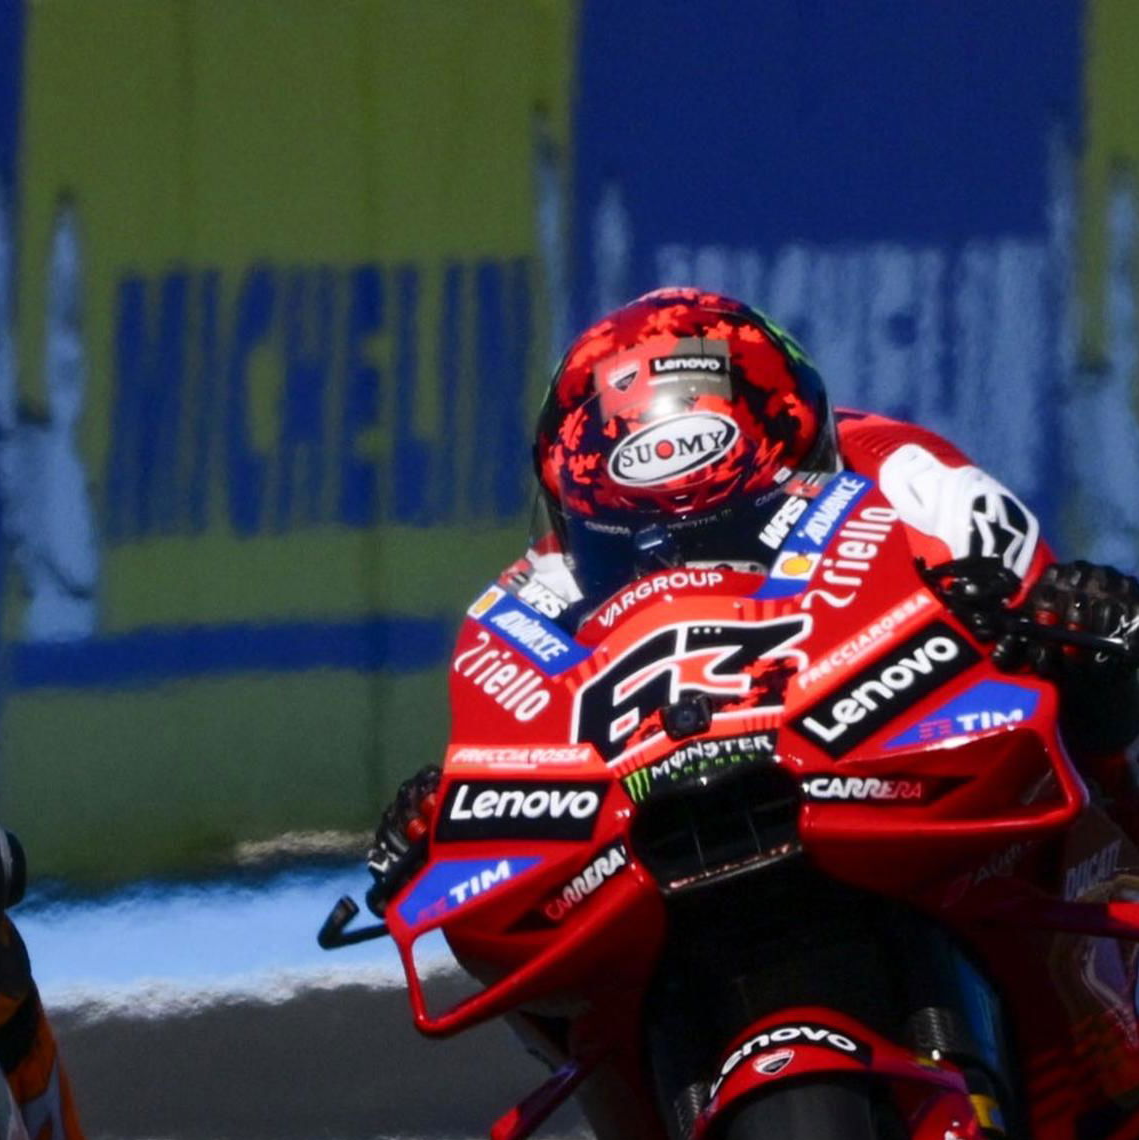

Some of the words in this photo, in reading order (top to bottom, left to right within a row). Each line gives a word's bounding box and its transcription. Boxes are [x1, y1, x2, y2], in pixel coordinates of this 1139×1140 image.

[653, 358, 721, 372] Lenovo
[103, 258, 535, 545] MICHELIN
[620, 428, 726, 469] SUOMY
[758, 495, 808, 550] WRS
[804, 476, 866, 546] ADVANCE
[598, 571, 724, 627] VARGROUP
[490, 610, 569, 662] ADVANCE
[796, 593, 933, 692] FRECCIAROSSA
[803, 635, 959, 743] Lenovo
[956, 708, 1024, 732] TIM
[650, 734, 774, 780] MONSTER
[450, 784, 599, 820] Lenovo
[808, 777, 922, 799] CARRERA
[449, 859, 511, 904] TIM
[545, 846, 626, 920] CARRERA
